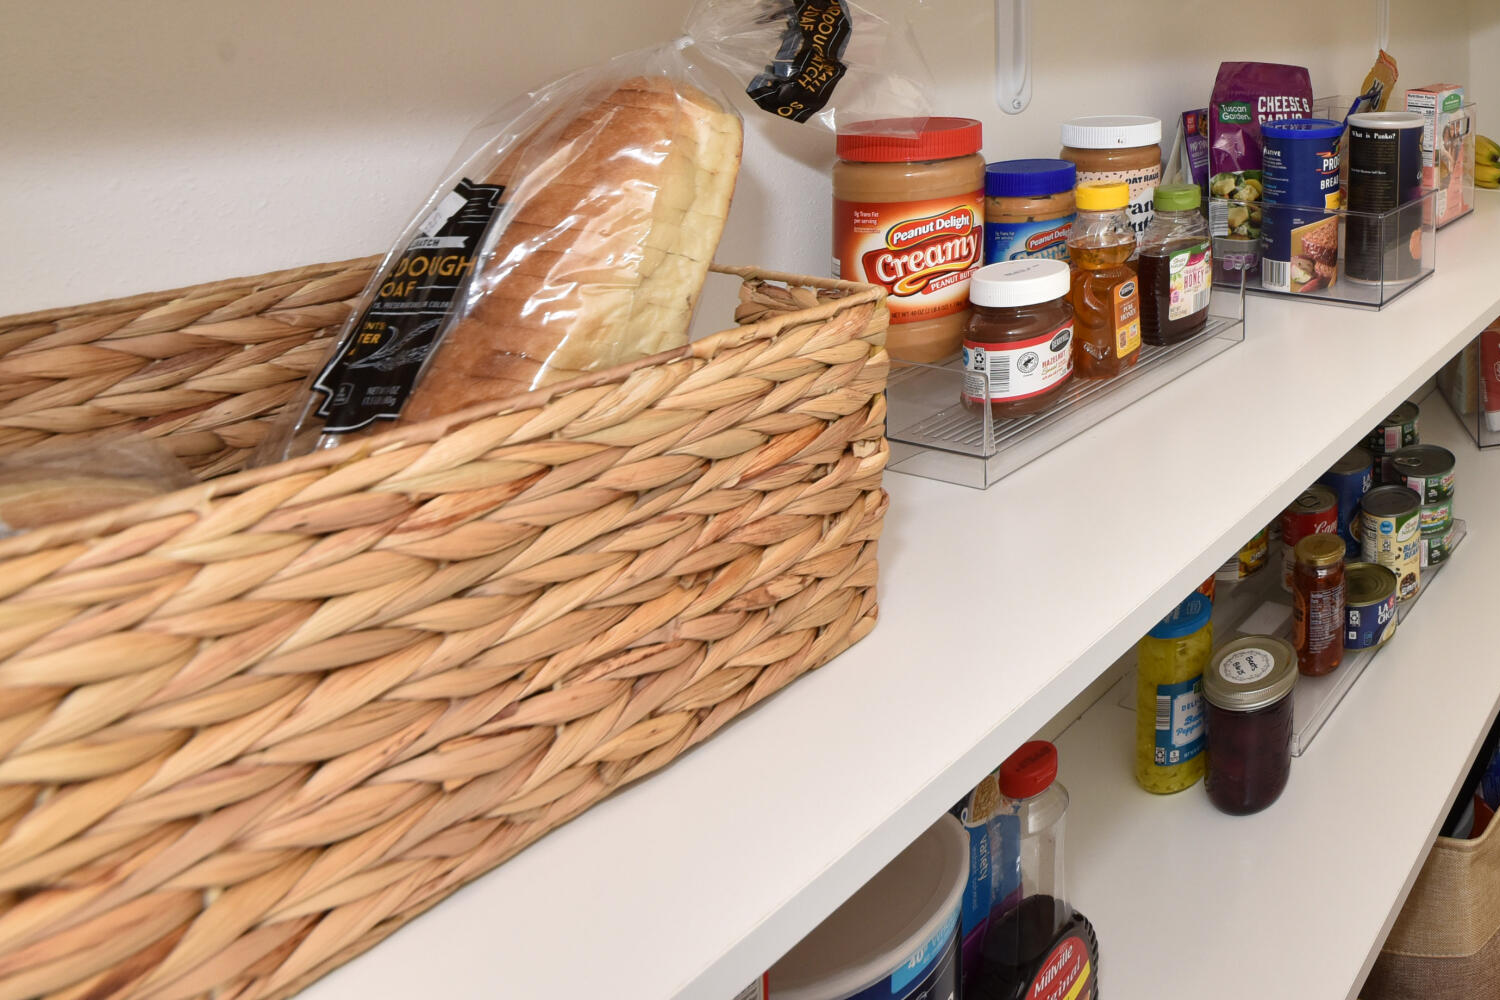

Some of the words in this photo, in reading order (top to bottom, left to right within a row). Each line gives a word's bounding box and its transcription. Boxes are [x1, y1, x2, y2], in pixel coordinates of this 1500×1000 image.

[1221, 104, 1247, 113] Tuscan
[1258, 96, 1302, 113] CHEESE
[1222, 112, 1250, 121] Garden
[1352, 131, 1363, 139] What
[1373, 132, 1396, 140] Panko?
[893, 222, 934, 245] Peanut
[935, 214, 970, 231] Delight
[1030, 233, 1054, 248] Peanut
[387, 255, 478, 278] DOUGH
[876, 233, 979, 283] Creamy
[930, 275, 959, 291] PEANUT
[959, 270, 975, 281] BUT
[1183, 269, 1205, 289] HONEY
[380, 281, 416, 297] OAF
[1378, 604, 1389, 616] LA
[1033, 943, 1073, 998] Millville
